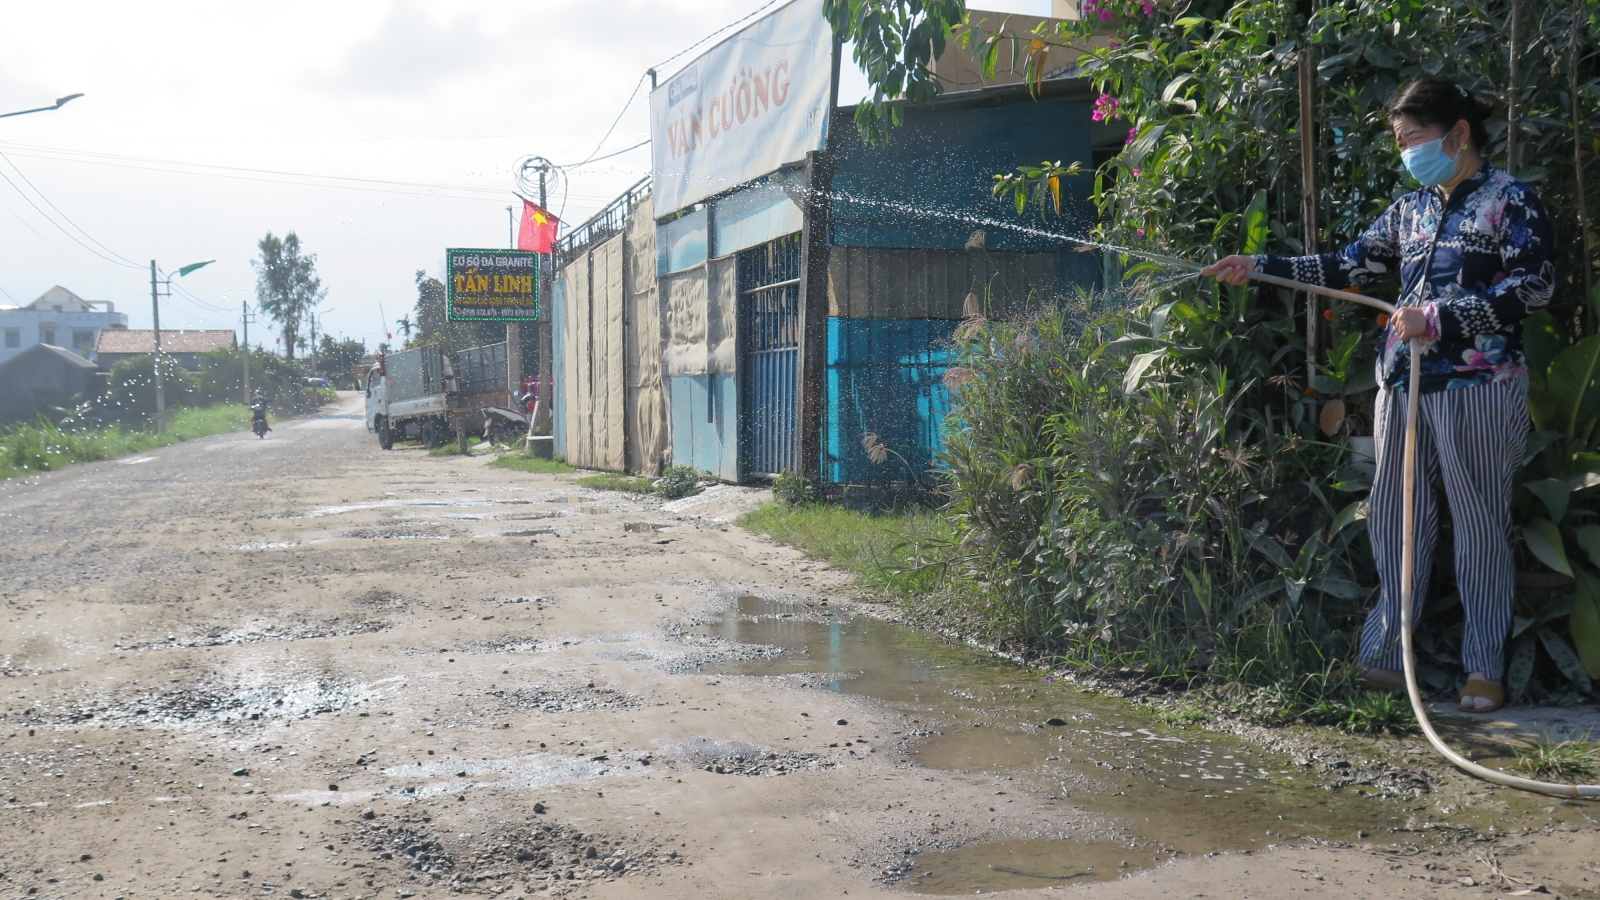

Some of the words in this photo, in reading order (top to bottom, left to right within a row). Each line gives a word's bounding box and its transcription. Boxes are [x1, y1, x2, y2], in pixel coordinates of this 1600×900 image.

[667, 103, 703, 160] VĂN
[709, 58, 790, 139] CƯỜNG
[453, 255, 465, 266] CƠ
[466, 253, 480, 267] SỞ
[480, 254, 494, 267] ĐÁ
[495, 256, 534, 267] GRANITE
[454, 267, 489, 293] TẤN
[493, 274, 533, 293] LINH
